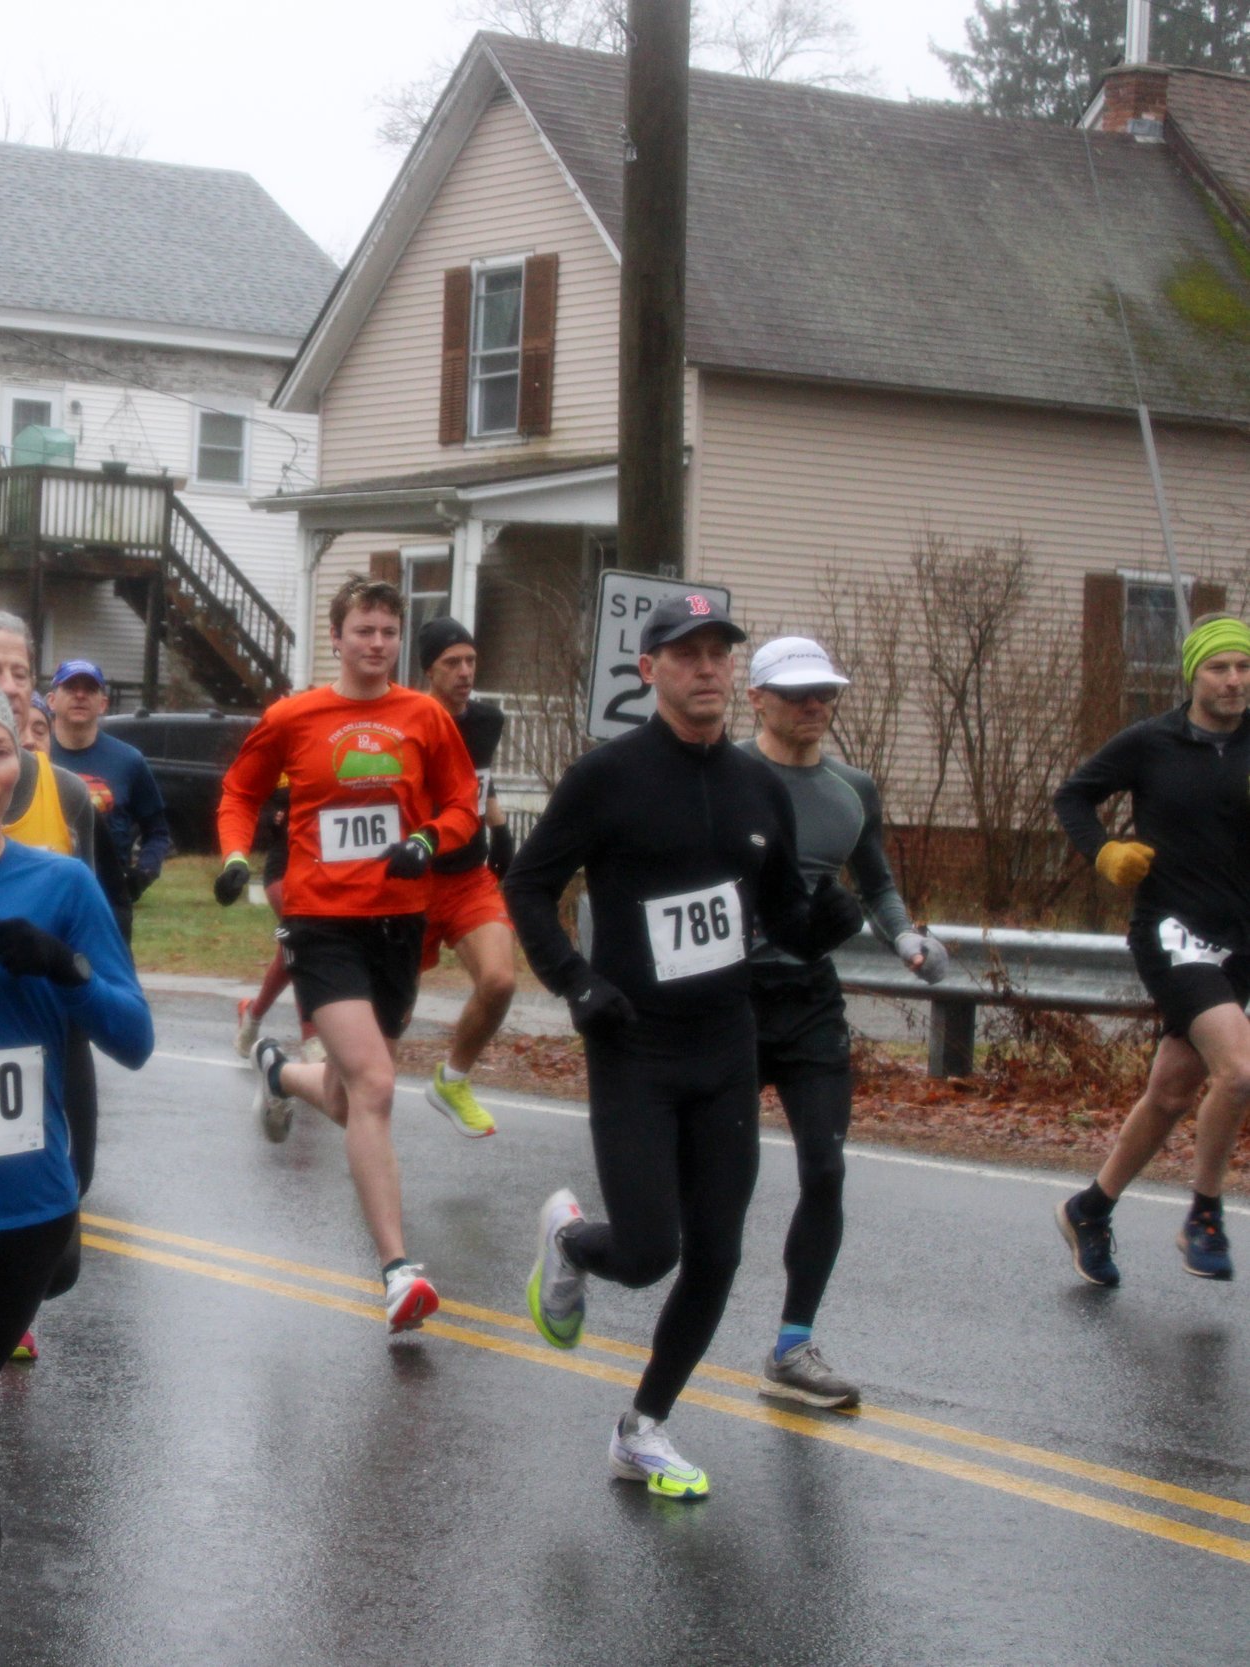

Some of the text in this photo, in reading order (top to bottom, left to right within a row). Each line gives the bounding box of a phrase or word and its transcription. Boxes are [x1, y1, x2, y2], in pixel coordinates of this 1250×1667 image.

[686, 594, 711, 616] B
[333, 813, 387, 849] 706
[662, 895, 731, 951] 786
